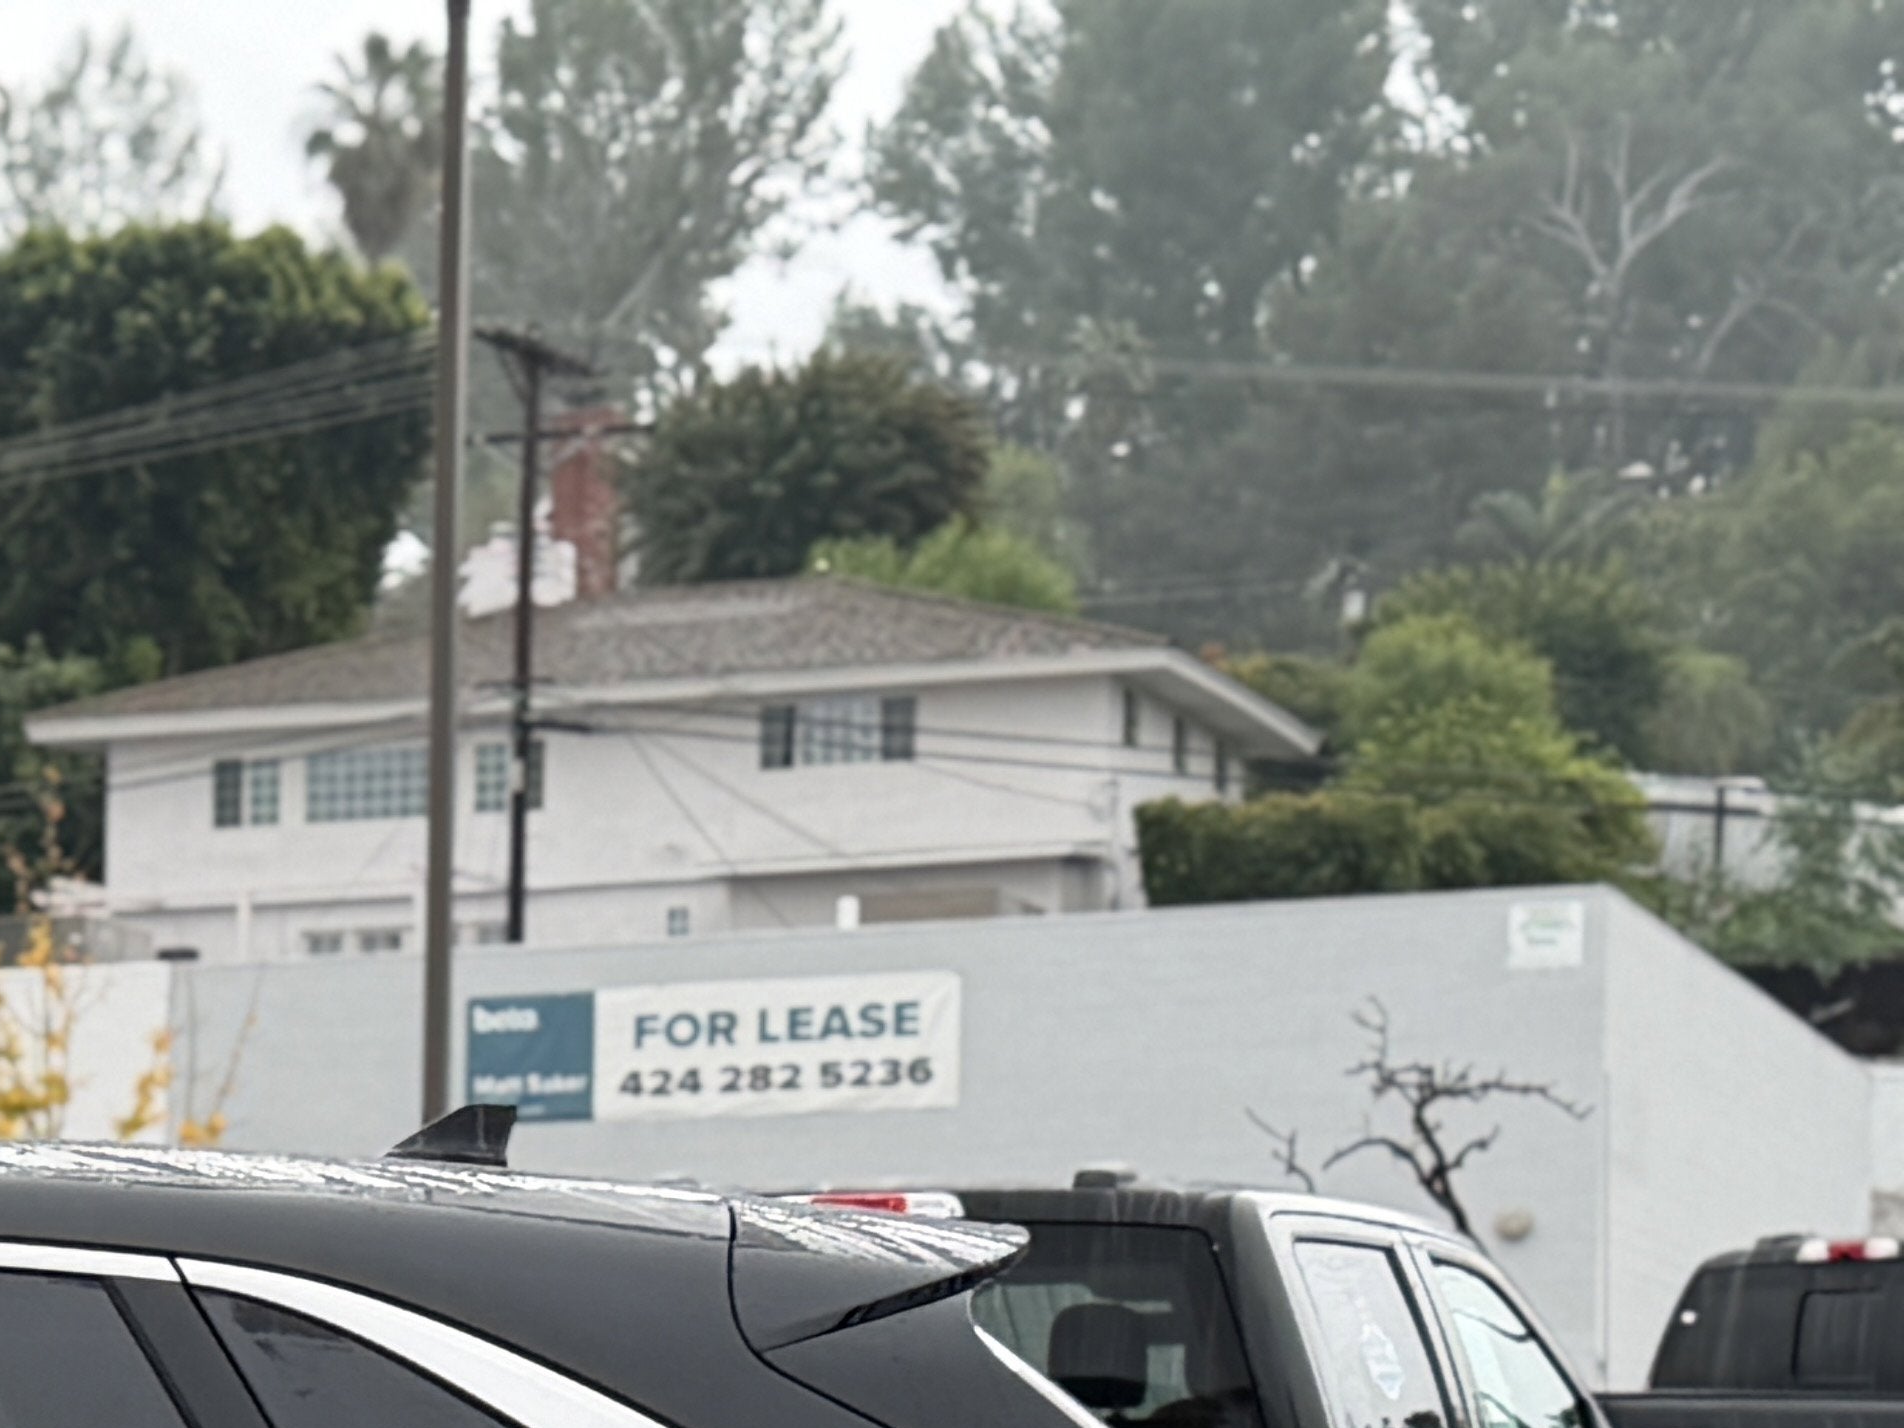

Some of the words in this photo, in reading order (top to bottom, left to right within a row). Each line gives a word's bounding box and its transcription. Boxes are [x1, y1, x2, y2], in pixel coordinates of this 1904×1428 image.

[632, 1010, 739, 1050] FOR
[758, 1001, 921, 1045] LEASE
[618, 1067, 703, 1098] 424
[718, 1062, 803, 1094] 282
[819, 1055, 934, 1090] 5236
